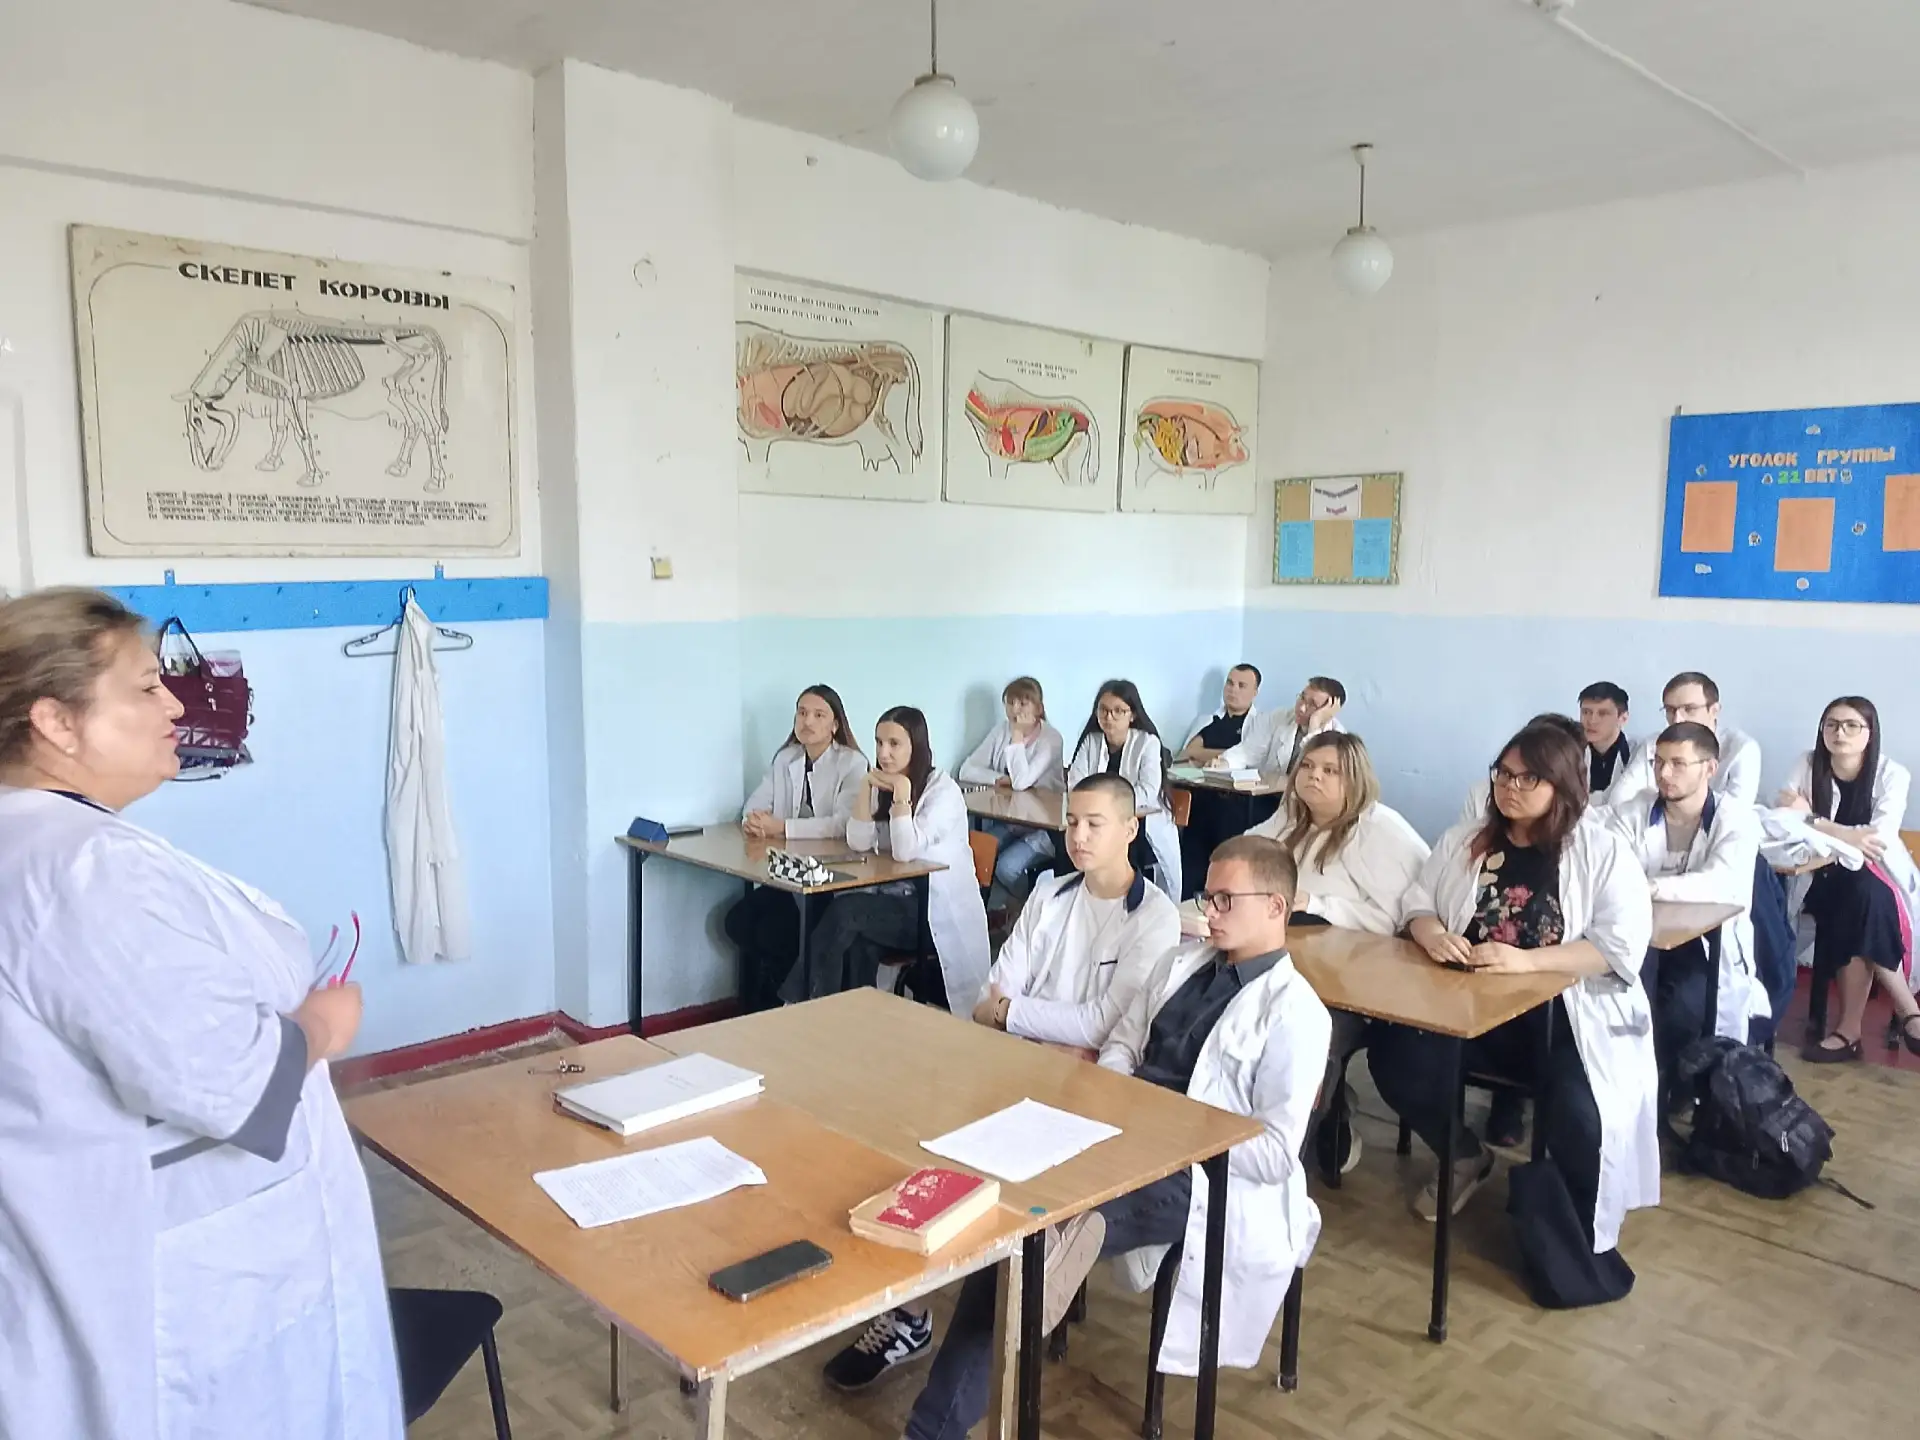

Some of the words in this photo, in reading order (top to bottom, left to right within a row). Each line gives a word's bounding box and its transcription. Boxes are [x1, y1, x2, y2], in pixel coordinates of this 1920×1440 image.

[178, 262, 296, 292] СКЕЛЕТ
[319, 279, 449, 310] КОРОВЫ
[1728, 452, 1798, 468] УГОЛОК
[1817, 446, 1896, 464] ГРУППЫ
[1804, 468, 1838, 484] ВЕТ
